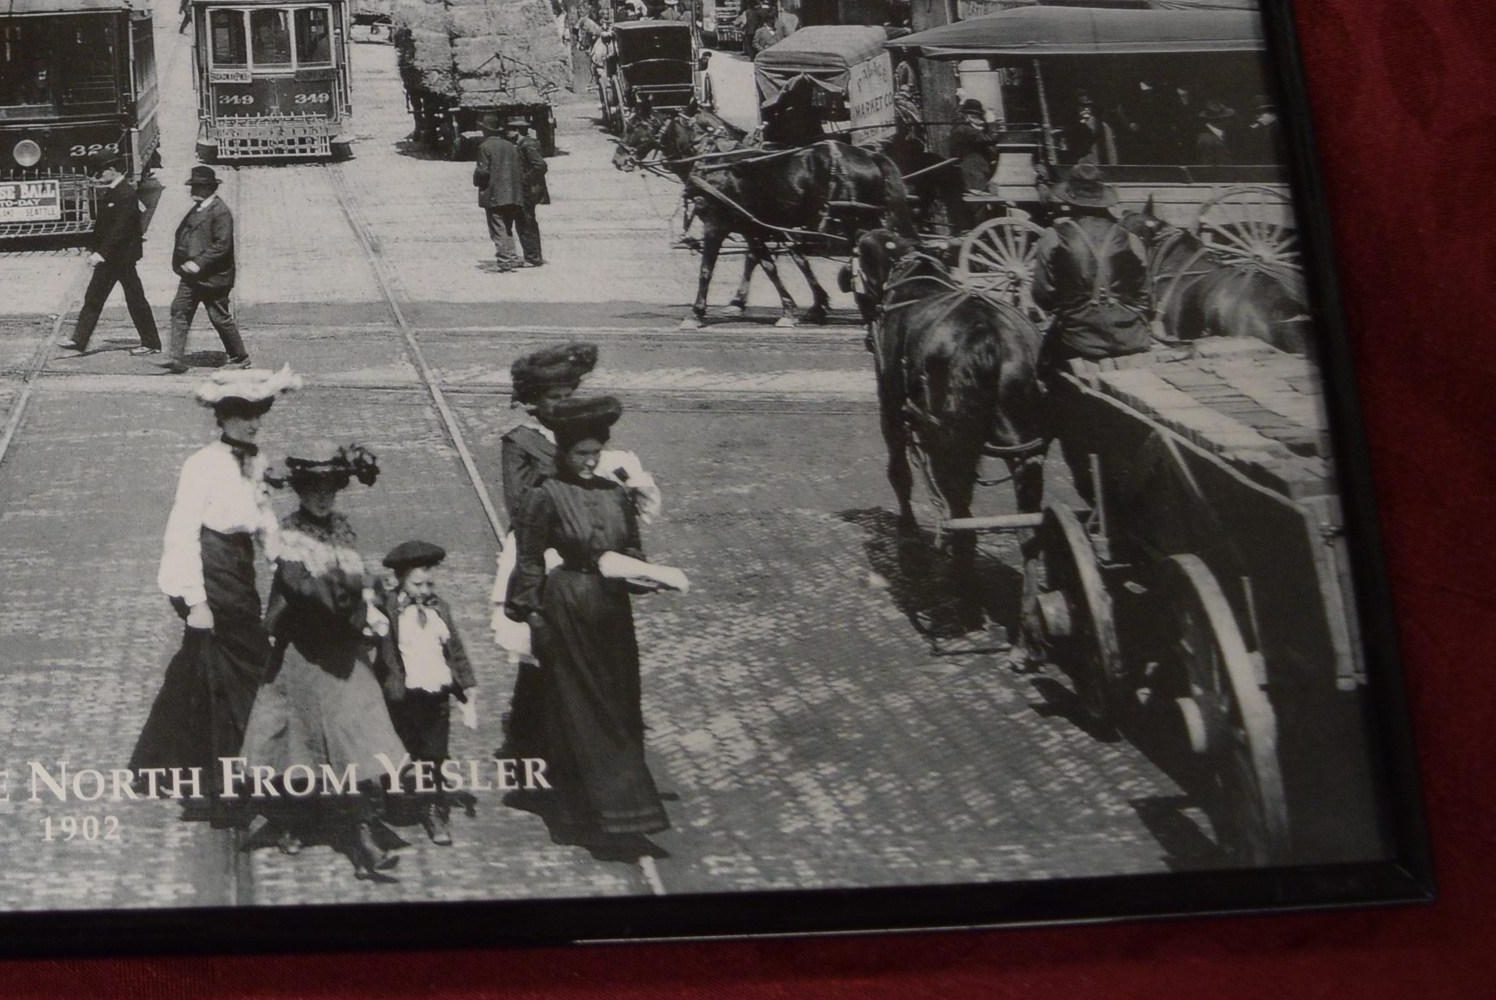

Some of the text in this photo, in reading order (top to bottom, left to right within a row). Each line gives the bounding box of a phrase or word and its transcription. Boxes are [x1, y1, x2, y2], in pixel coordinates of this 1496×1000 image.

[19, 182, 56, 199] BALL
[28, 760, 204, 803] NORTH
[217, 756, 361, 800] FROM
[374, 752, 554, 793] YESLER
[40, 815, 122, 842] 1902
